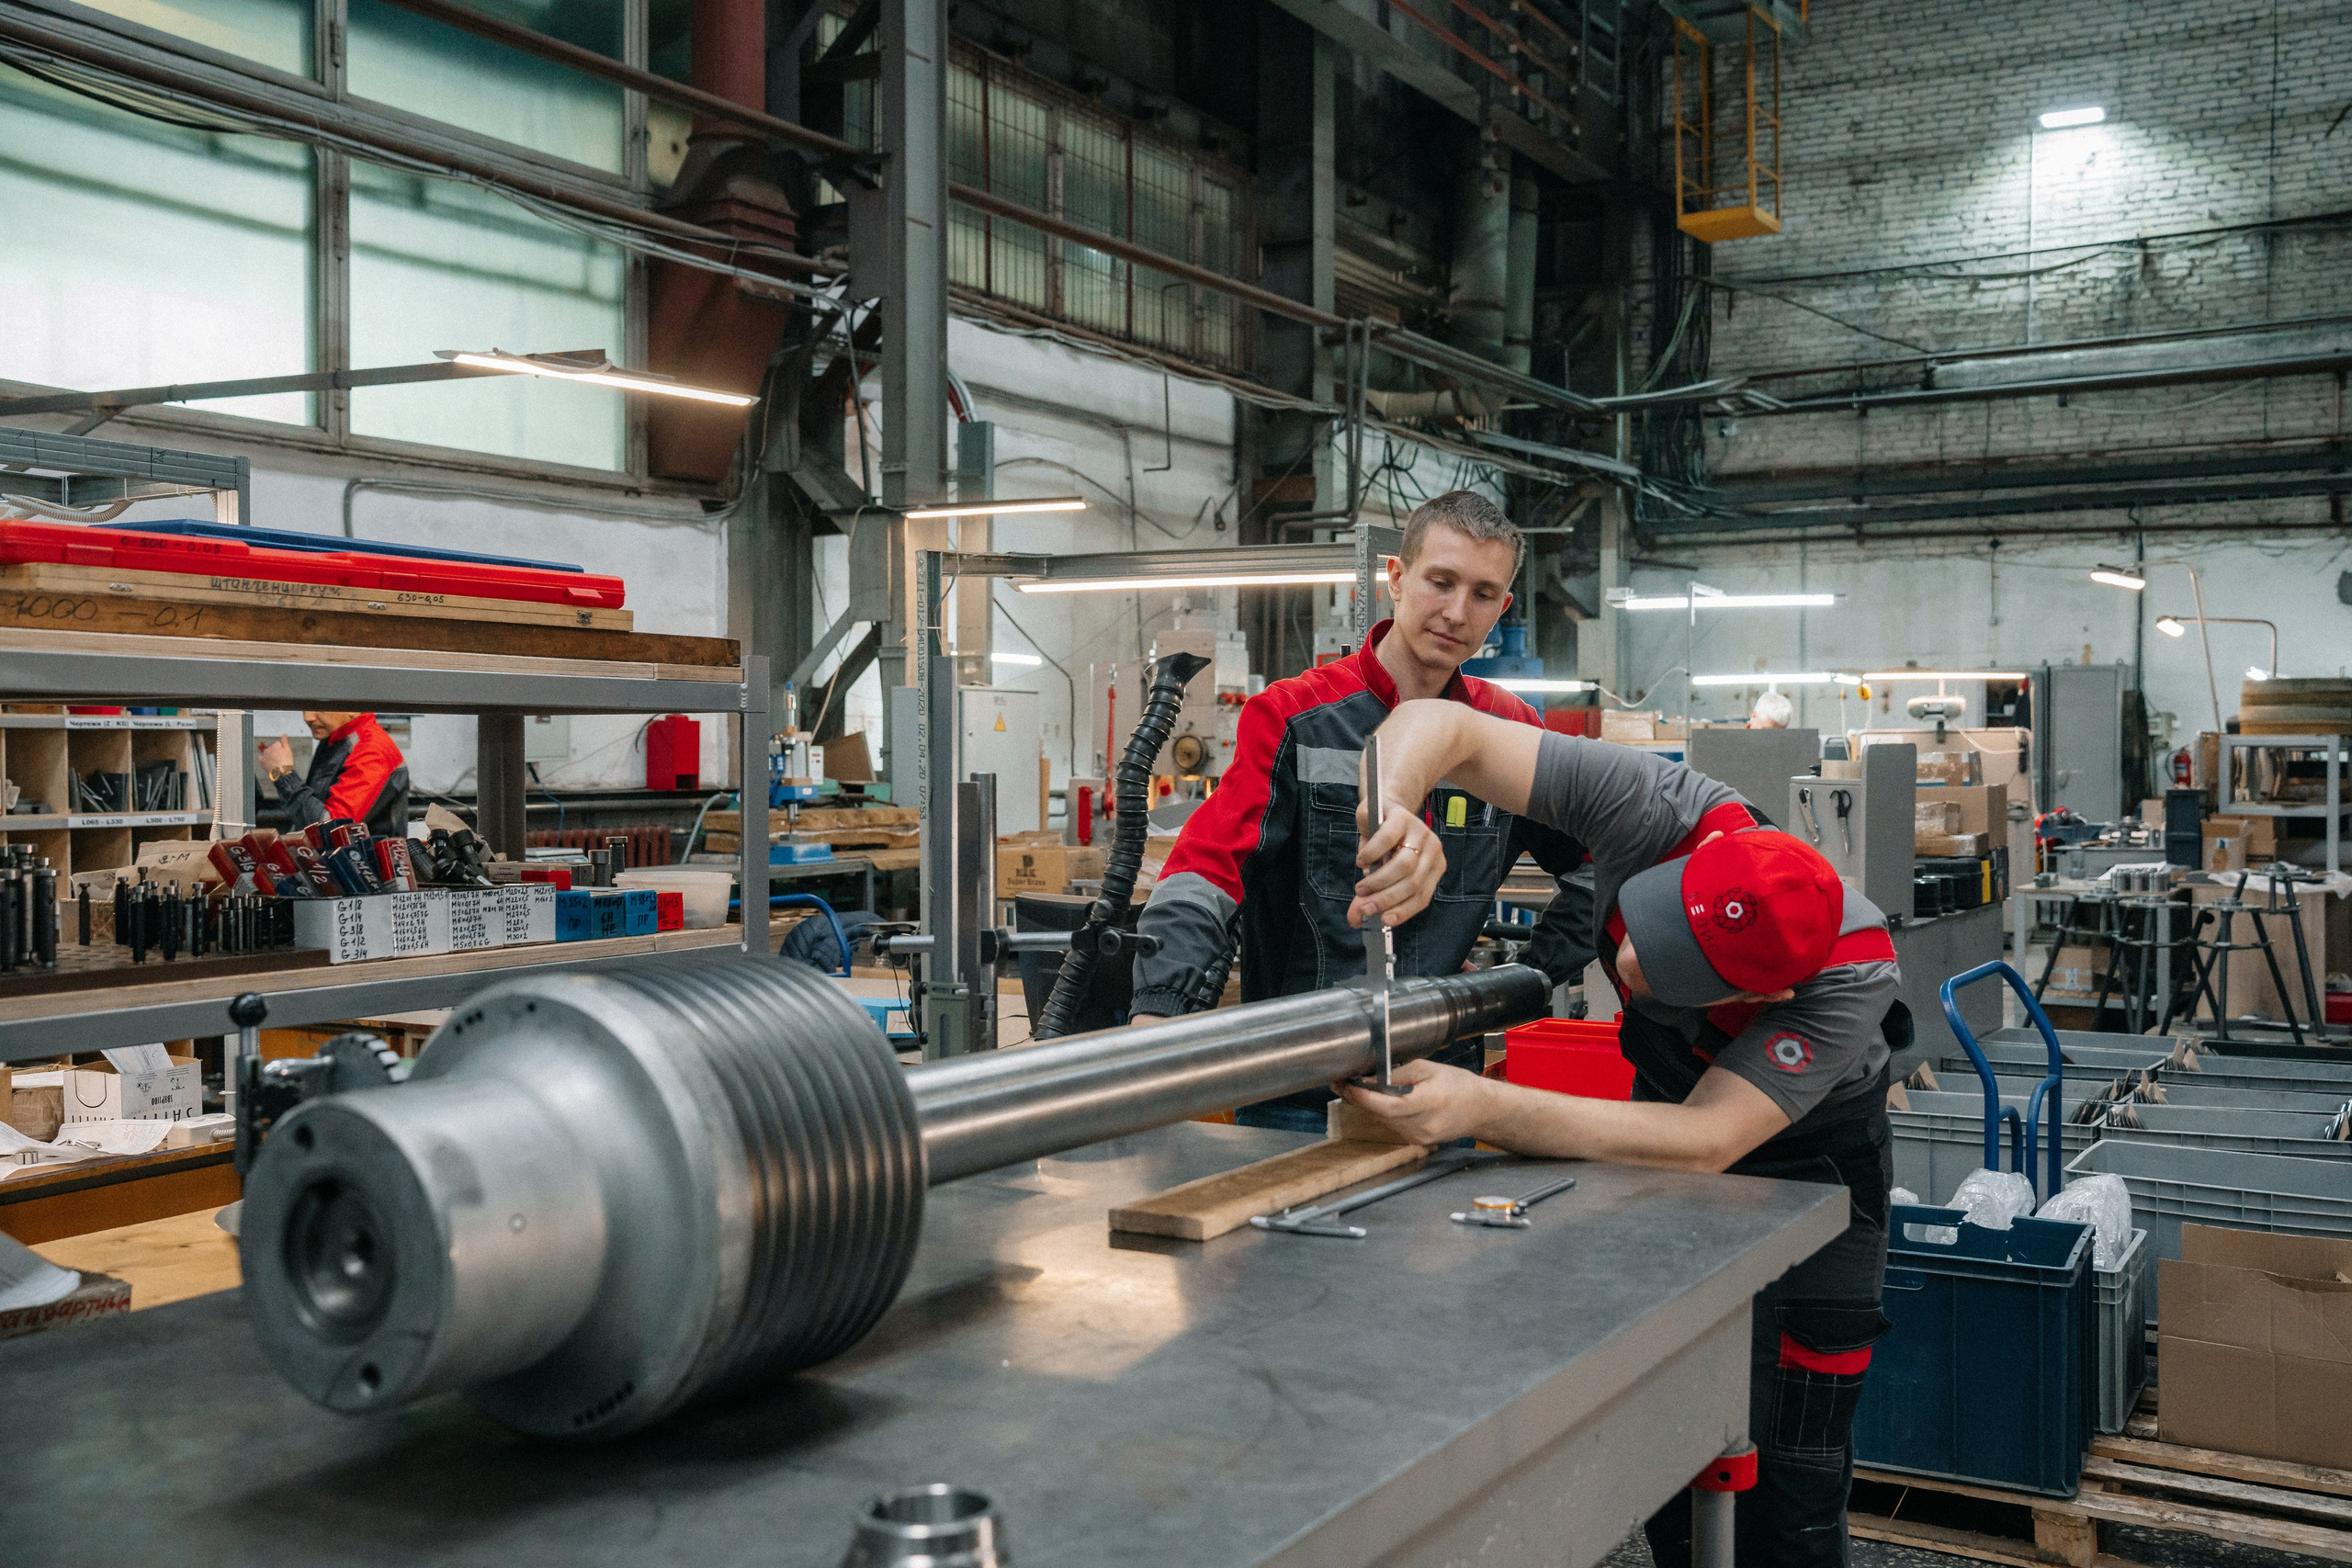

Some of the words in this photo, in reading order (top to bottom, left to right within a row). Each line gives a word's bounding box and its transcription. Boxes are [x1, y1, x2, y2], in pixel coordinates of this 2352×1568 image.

[918, 724, 926, 780] 02.04.20
[919, 785, 927, 820] 07:53
[309, 863, 330, 884] 1/2
[337, 901, 347, 912] G
[348, 899, 363, 912] 1/8
[338, 914, 348, 924] G
[349, 912, 363, 922] 1/4
[339, 926, 349, 936] G
[349, 924, 364, 936] 3/8
[340, 938, 349, 947] G
[351, 936, 367, 948] 1/2
[341, 950, 350, 959] G
[351, 948, 368, 960] 3/4
